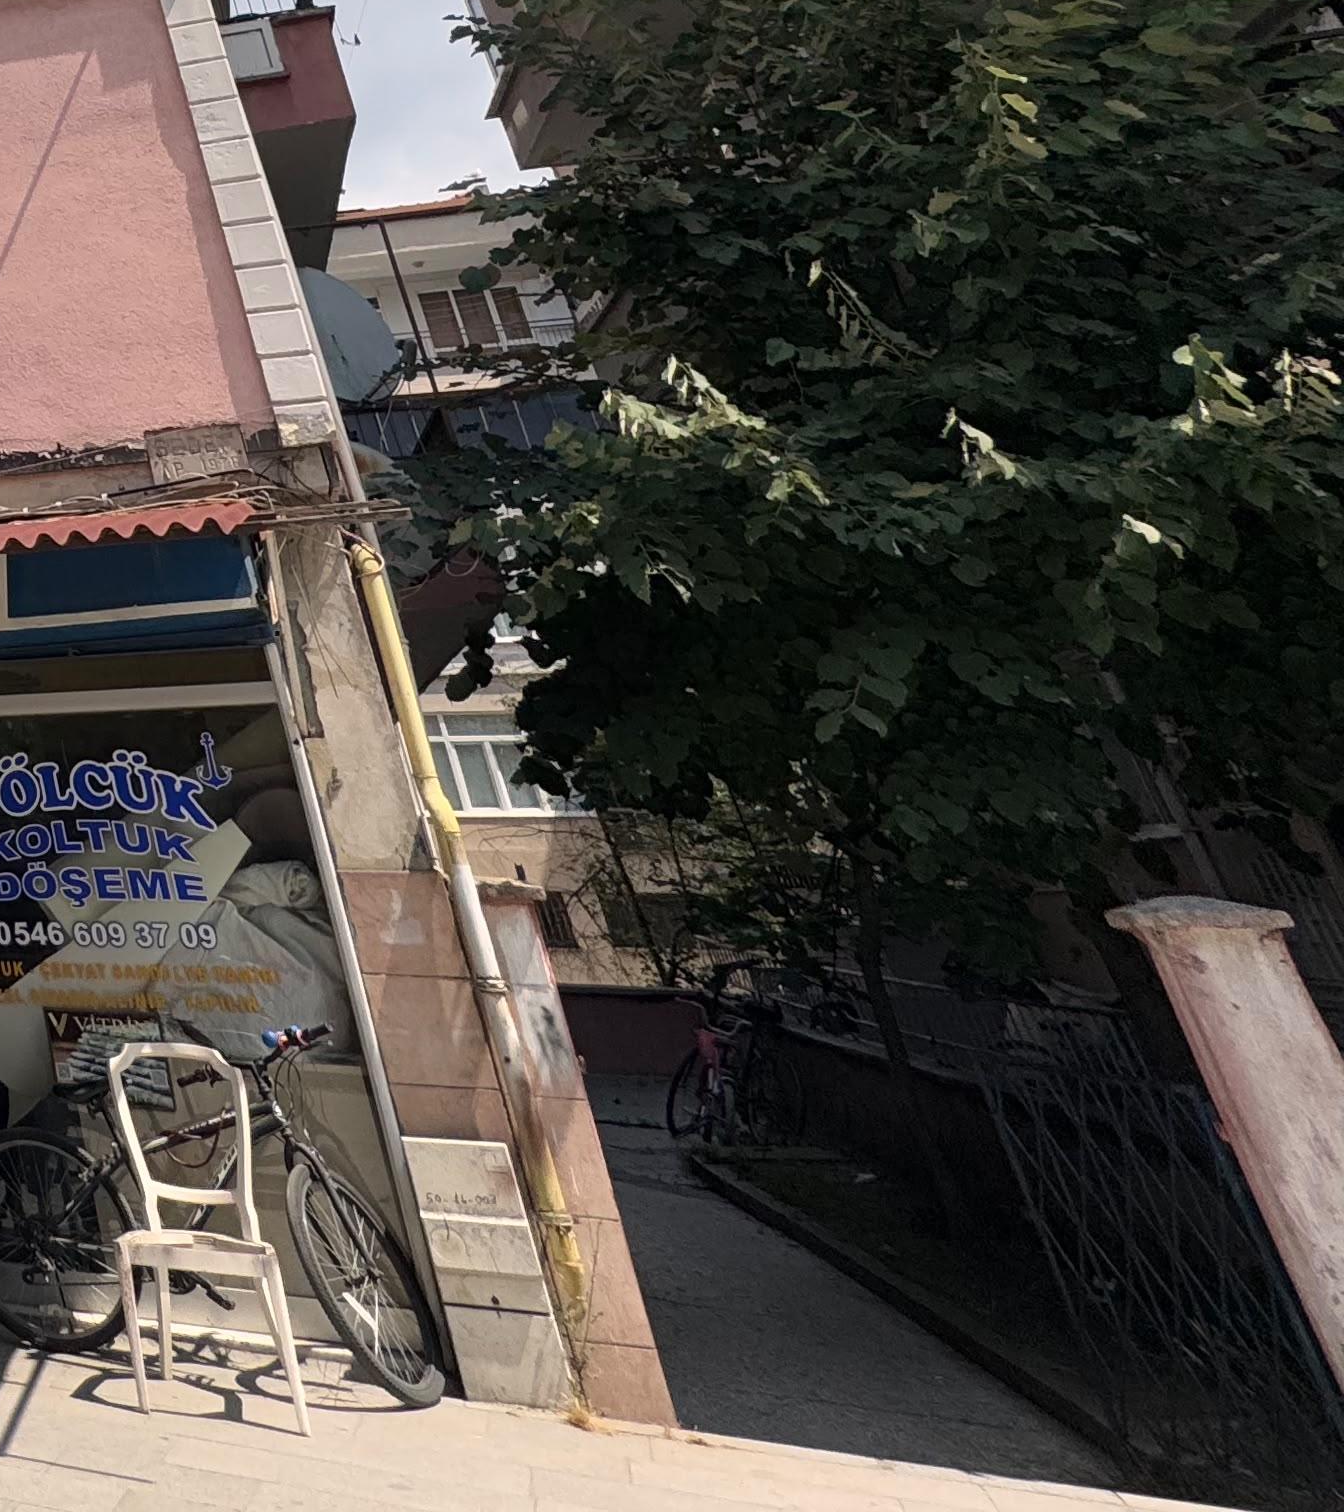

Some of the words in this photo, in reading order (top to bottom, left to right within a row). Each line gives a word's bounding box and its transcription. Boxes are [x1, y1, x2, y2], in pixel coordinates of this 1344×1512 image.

[72, 920, 125, 949] 609
[133, 921, 169, 949] 37
[179, 922, 218, 950] 09
